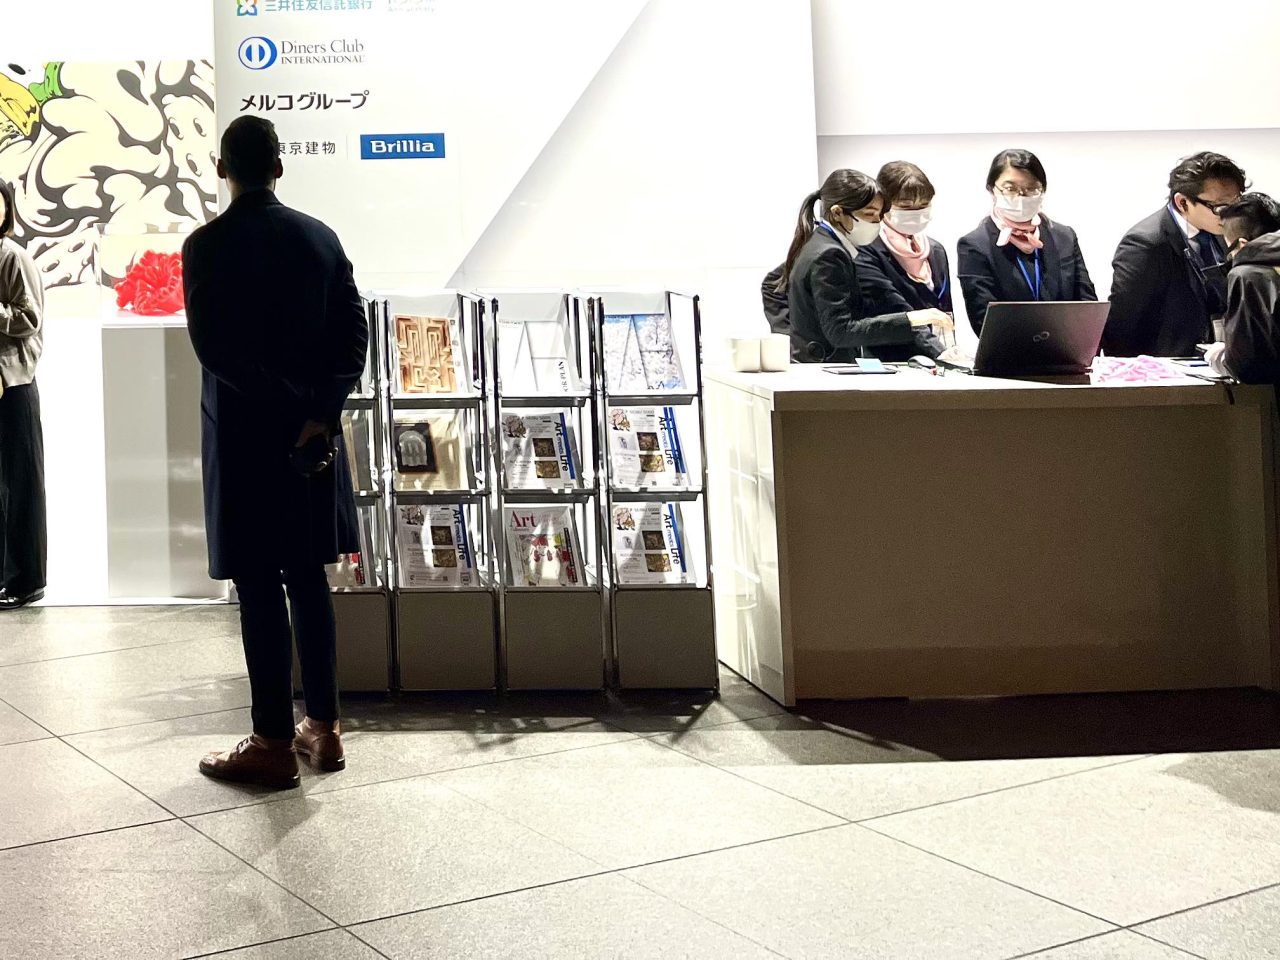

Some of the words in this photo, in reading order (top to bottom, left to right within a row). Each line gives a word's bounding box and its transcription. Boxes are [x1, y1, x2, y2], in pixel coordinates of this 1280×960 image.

[281, 40, 326, 54] Diners
[330, 38, 364, 53] Club
[281, 55, 365, 65] INTERNATIONAL
[240, 89, 370, 112] メルコグループ
[370, 139, 435, 154] Brillia
[554, 421, 563, 436] Art
[658, 416, 668, 430] Art
[452, 509, 461, 524] Art
[510, 510, 537, 527] Art
[664, 514, 673, 528] Art
